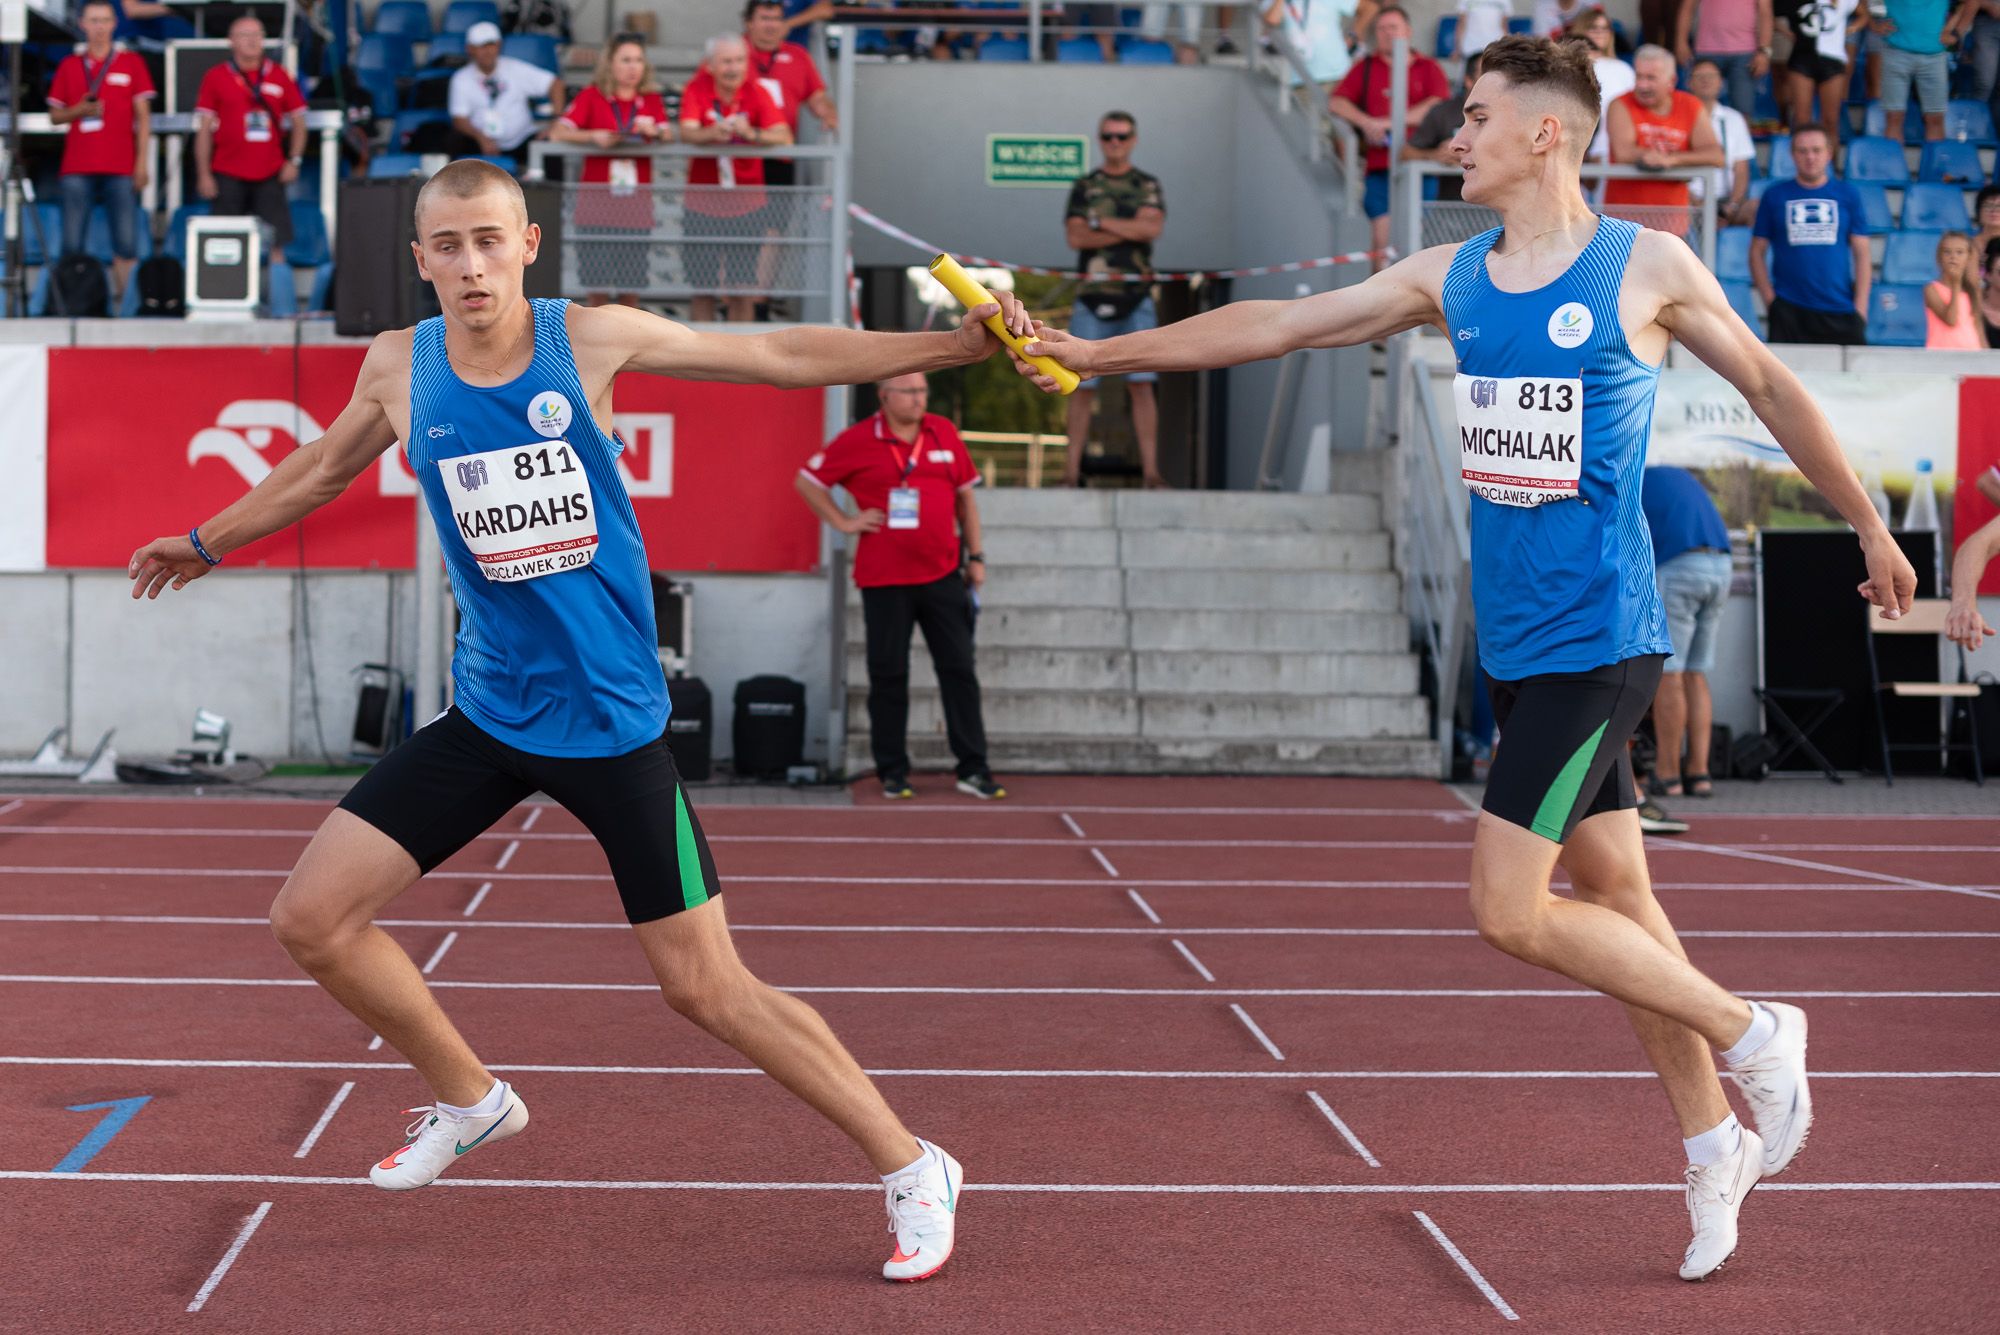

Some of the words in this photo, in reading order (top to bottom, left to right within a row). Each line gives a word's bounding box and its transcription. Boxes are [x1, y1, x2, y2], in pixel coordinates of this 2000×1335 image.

[1518, 382, 1573, 413] 813
[1461, 425, 1576, 463] MICHALAK
[513, 446, 577, 481] 811
[1474, 473, 1489, 481] PZLA
[1488, 475, 1530, 486] MISTRZOSTWA
[1530, 479, 1557, 488] POLSKI
[457, 493, 589, 539] KARDAHS
[493, 546, 547, 562] MISTRZOSTWA
[547, 541, 577, 552] POLSKI
[558, 550, 592, 569] 2021
